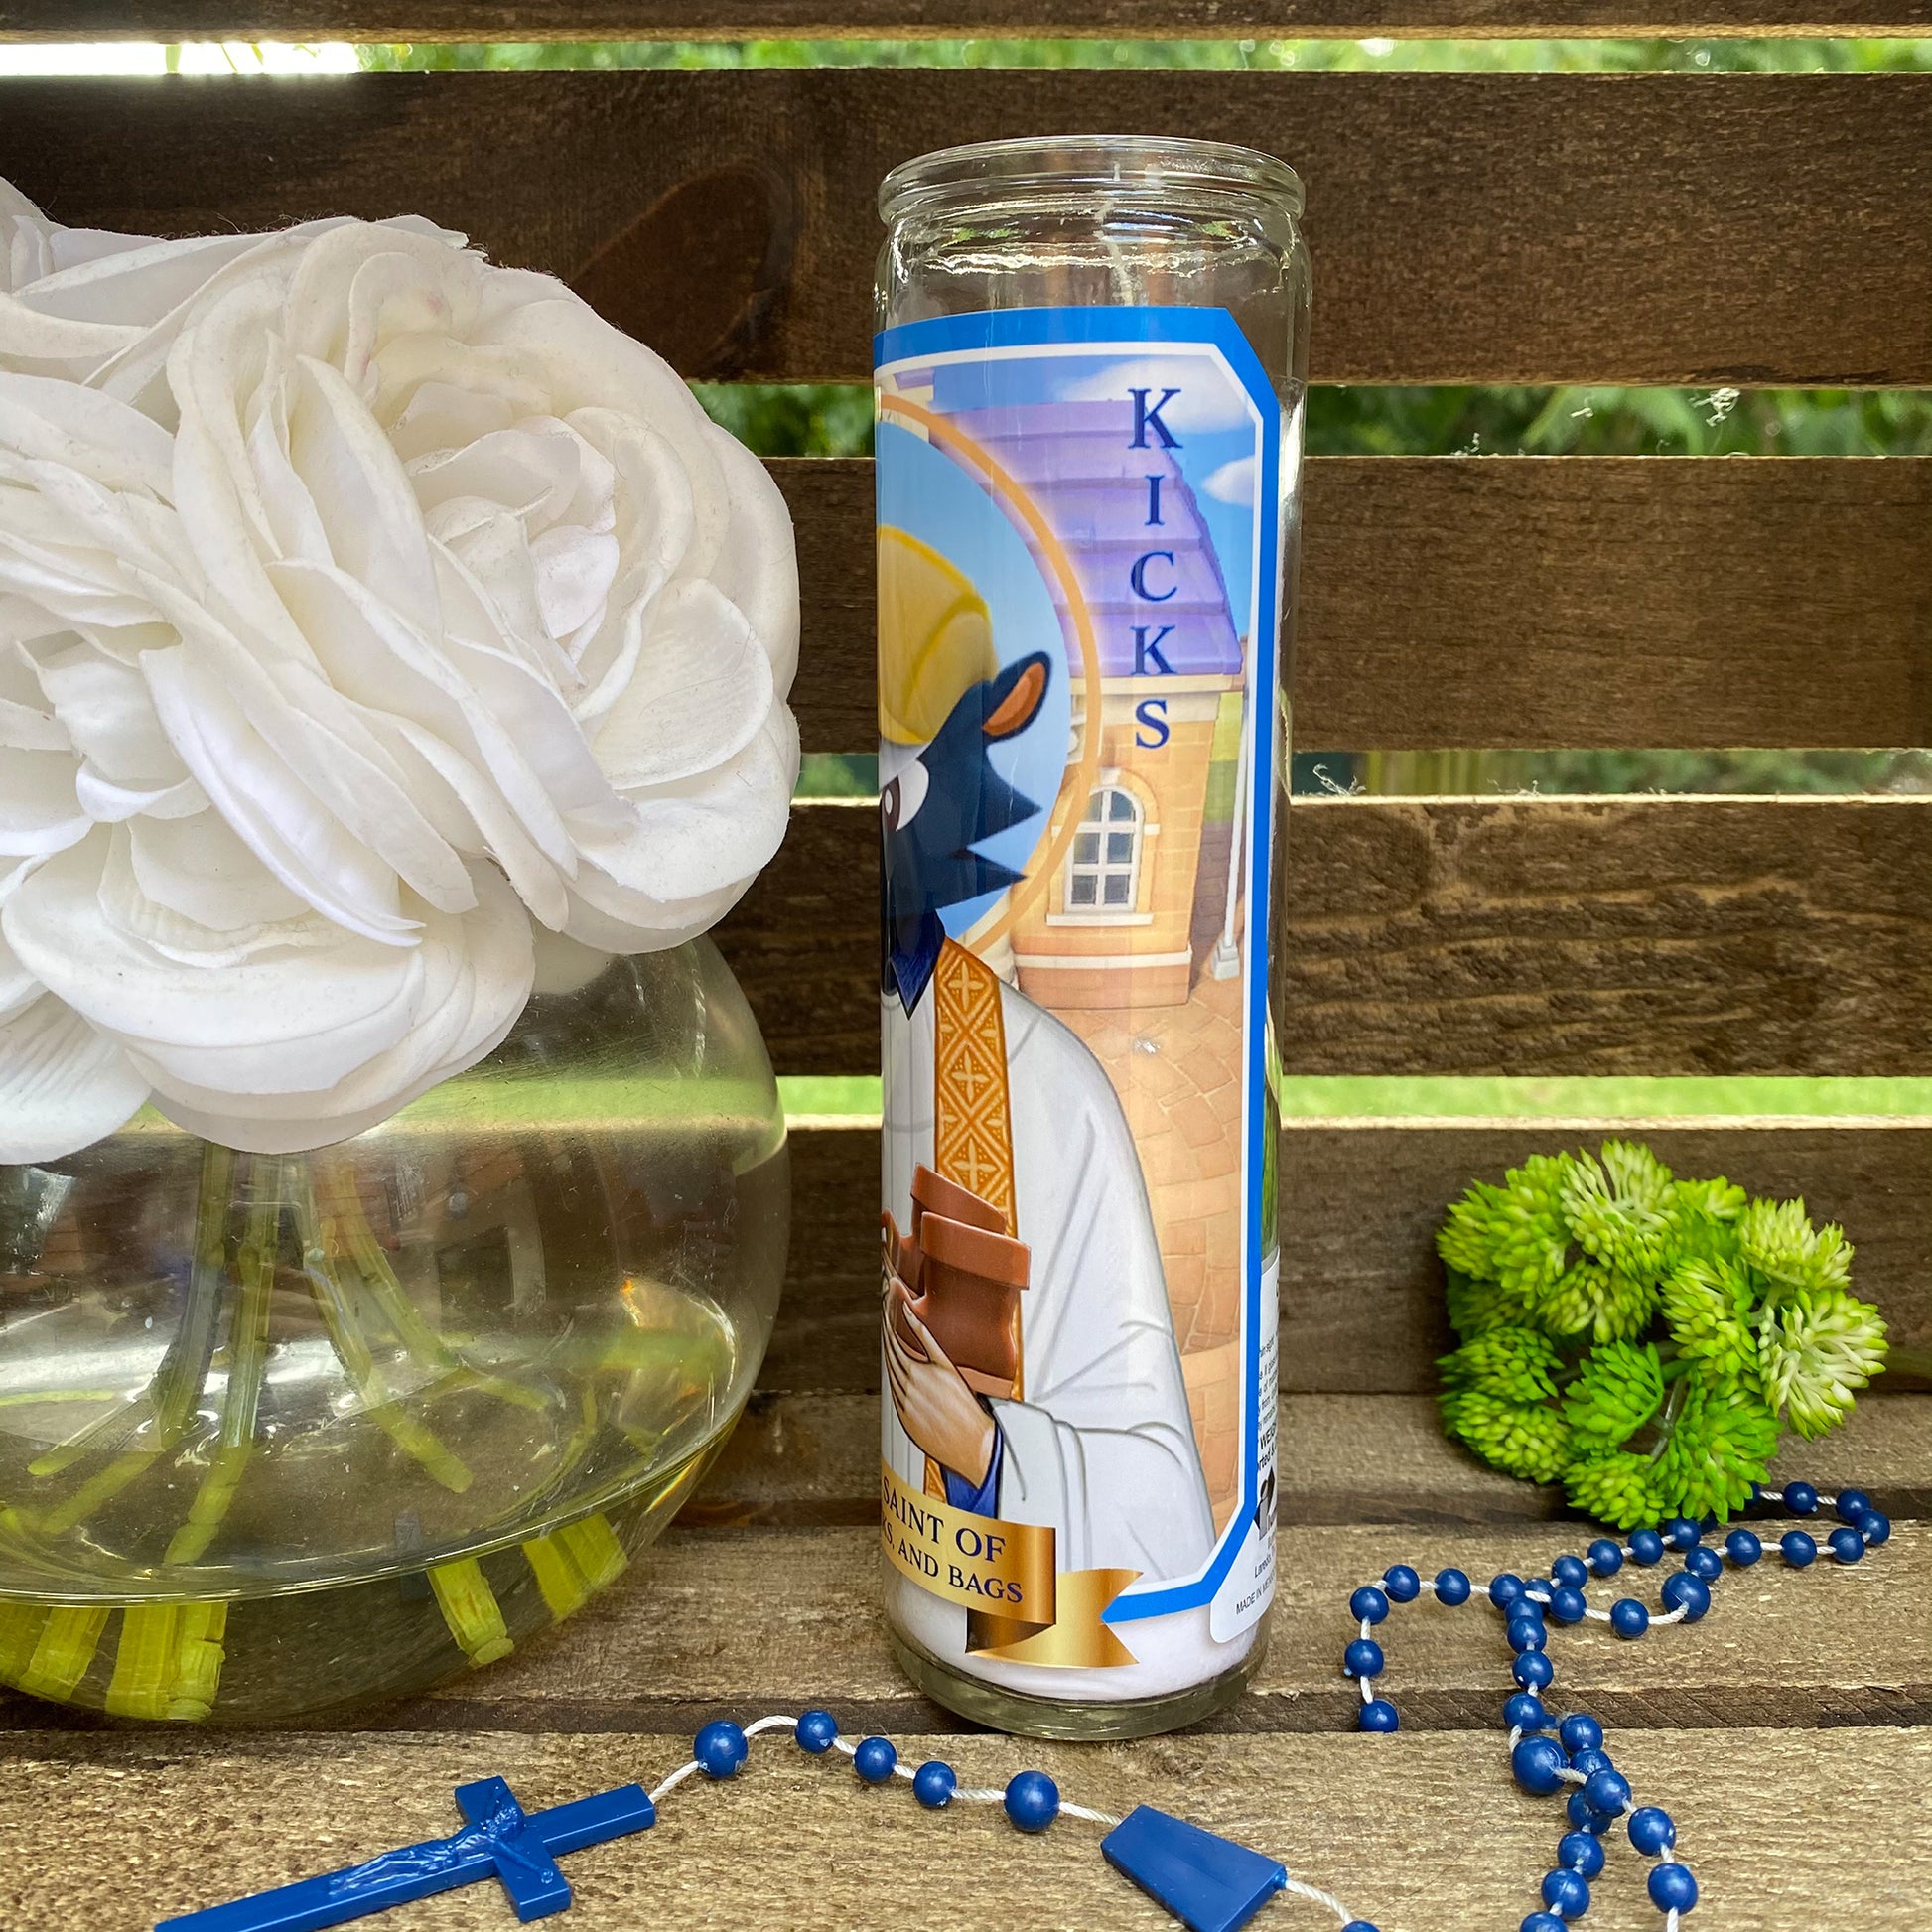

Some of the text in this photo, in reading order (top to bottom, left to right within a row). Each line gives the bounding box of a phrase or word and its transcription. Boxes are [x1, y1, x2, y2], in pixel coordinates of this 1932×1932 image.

[1127, 387, 1183, 750] KICKS
[883, 1475, 1006, 1563] SAINT OF
[897, 1537, 940, 1578] AND
[948, 1564, 1024, 1604] BAGS
[1235, 1591, 1256, 1615] MADE
